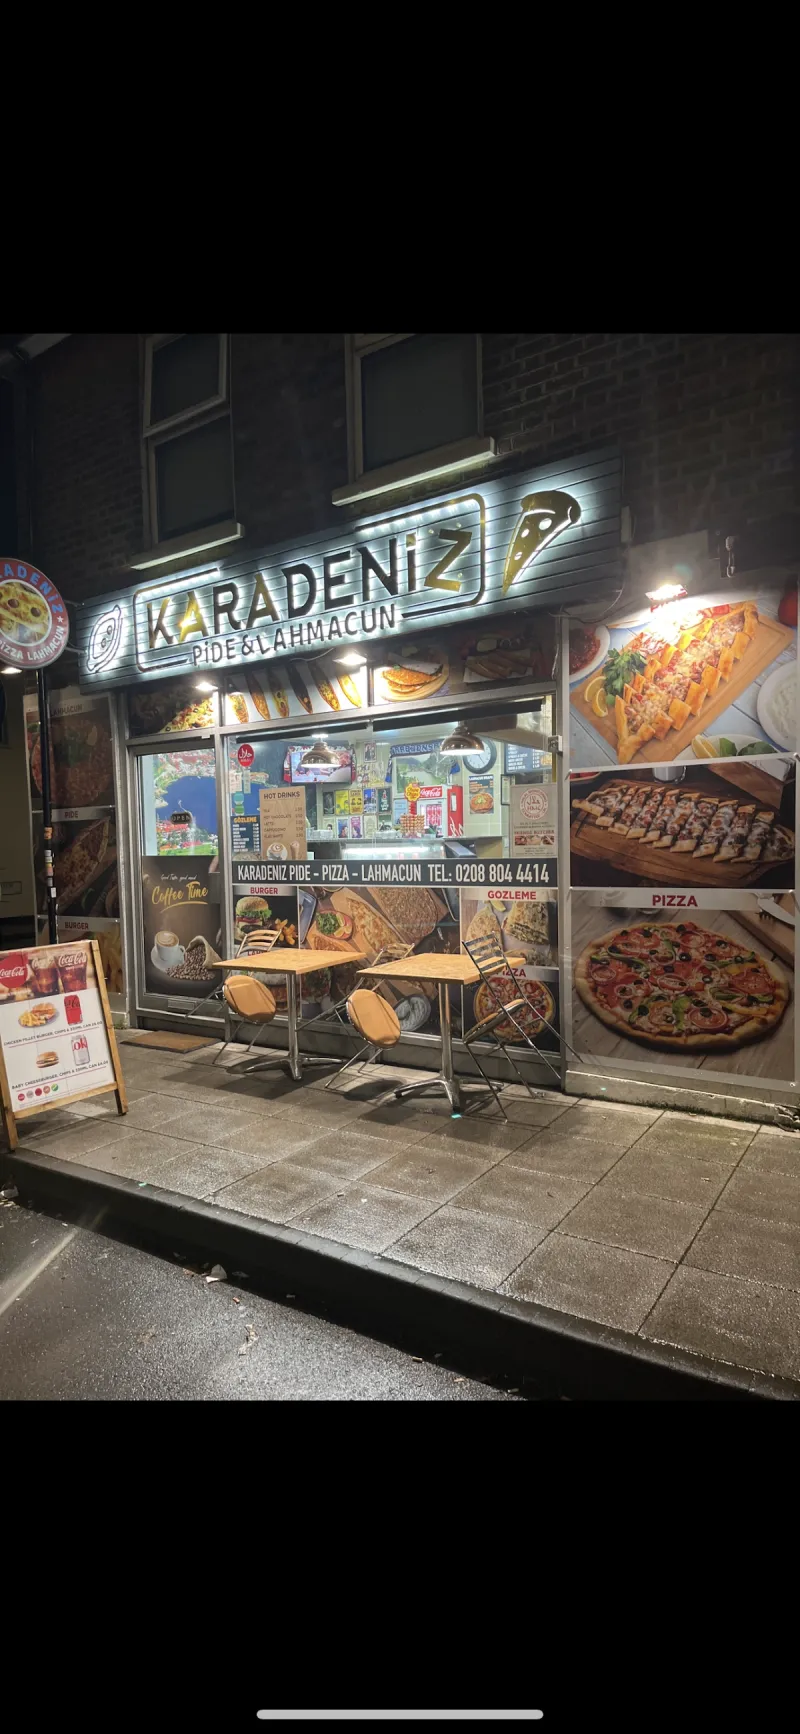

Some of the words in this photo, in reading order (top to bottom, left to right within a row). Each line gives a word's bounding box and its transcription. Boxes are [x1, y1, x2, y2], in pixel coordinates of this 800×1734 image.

[256, 603, 395, 655] LAHMACUN
[27, 625, 65, 661] LAHMACUN
[277, 790, 301, 799] DRINKS
[64, 810, 79, 819] PIDE
[238, 864, 287, 881] KARADENIZ
[289, 864, 311, 881] PIDE
[322, 864, 350, 881] PIZZA
[361, 864, 422, 882] LAHMACUN
[427, 863, 452, 882] TEL:
[455, 863, 485, 882] 0208
[489, 863, 512, 883] 804
[516, 863, 549, 883] 4414
[152, 885, 184, 905] Coffee
[186, 880, 208, 900] Time
[250, 887, 279, 895] BURGER
[487, 890, 537, 900] GOZLEME
[652, 894, 698, 907] PIZZA
[64, 921, 89, 930] BURGER
